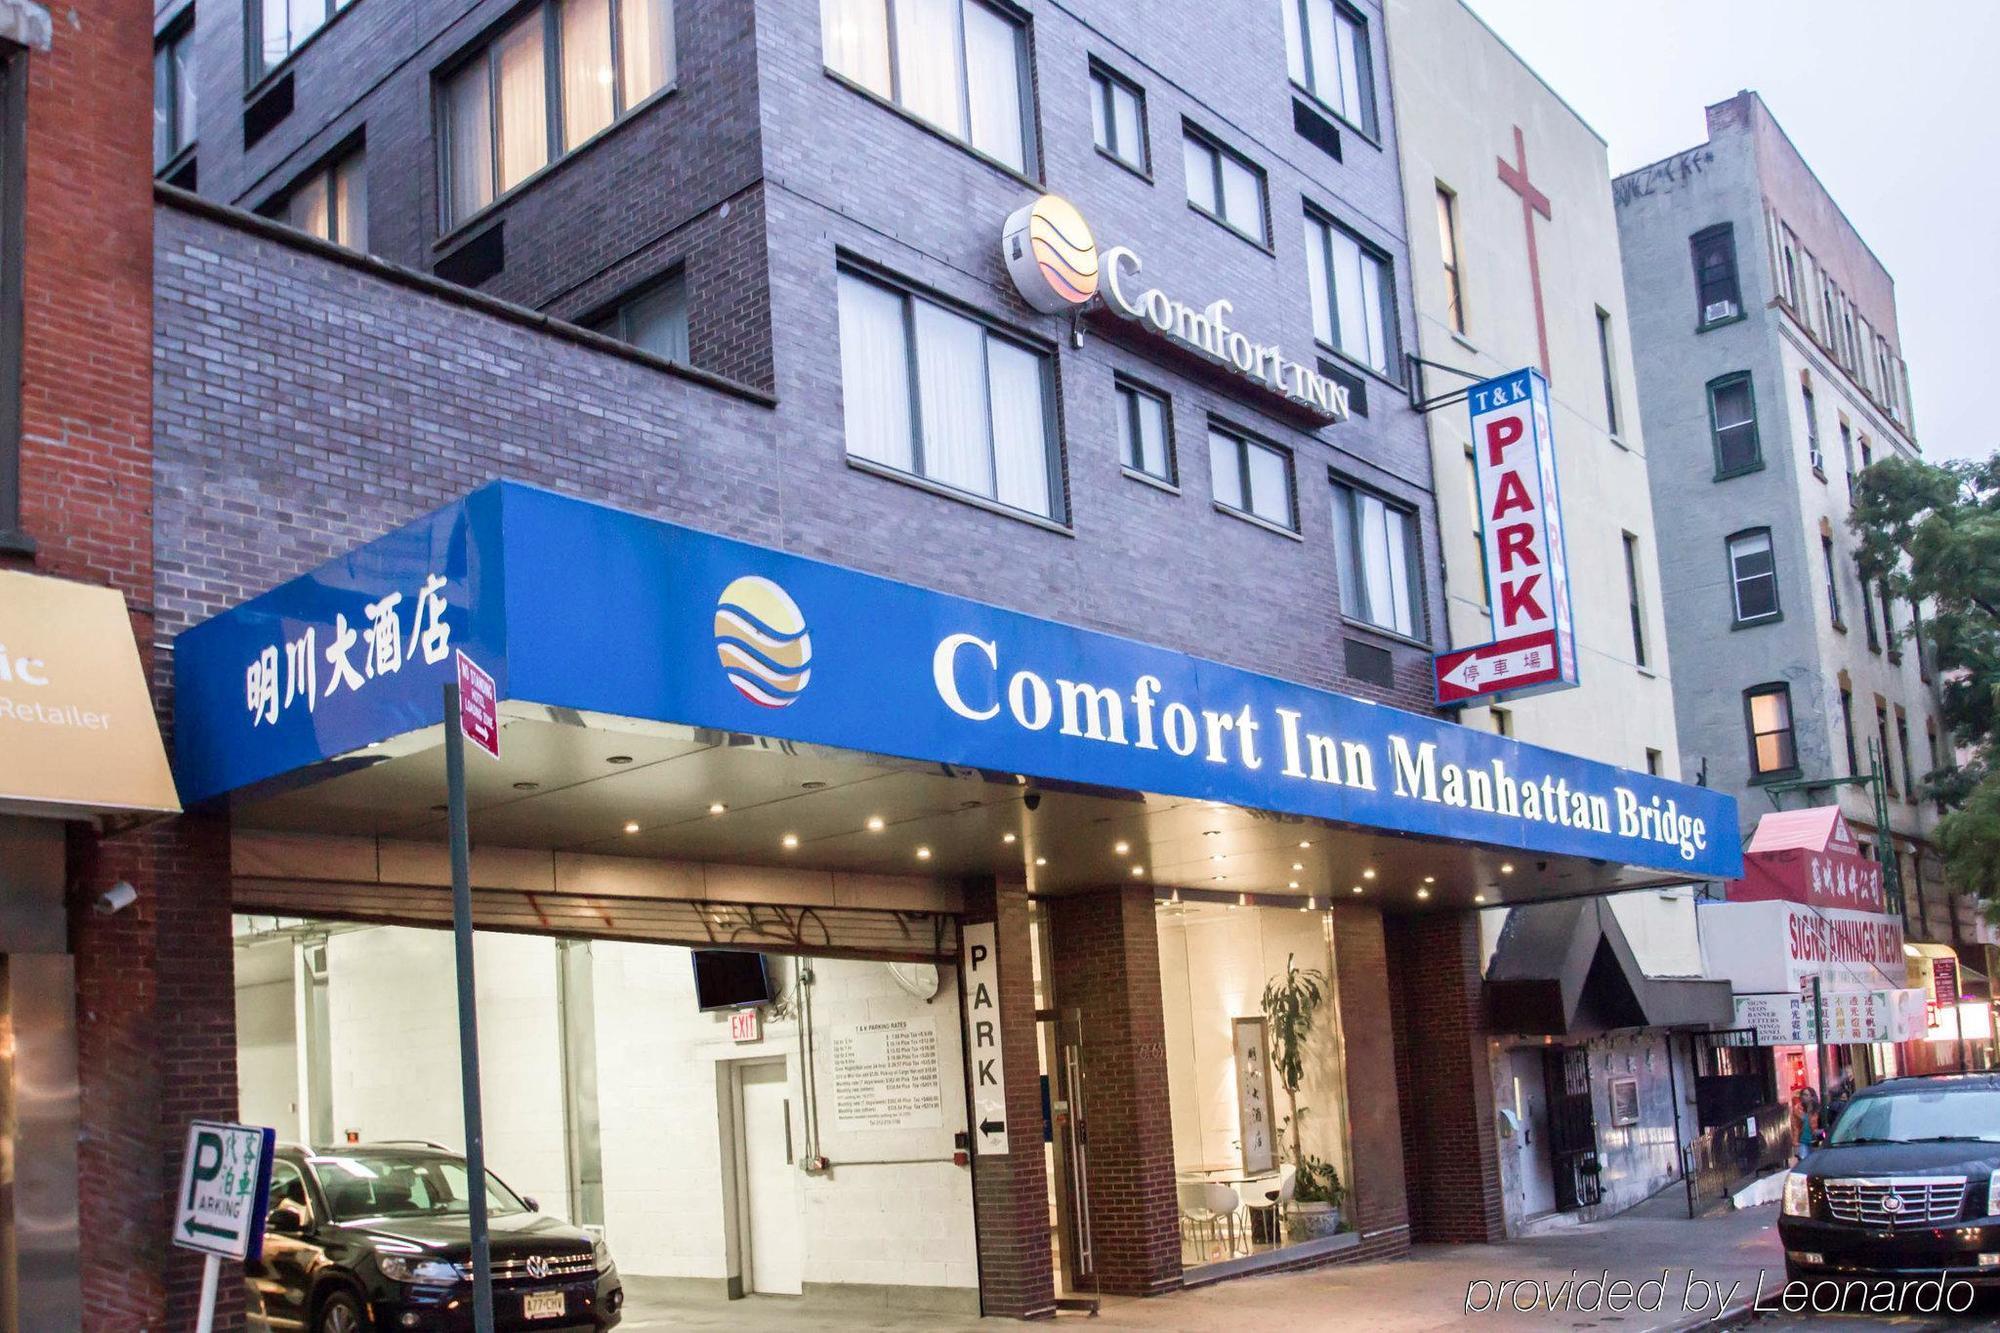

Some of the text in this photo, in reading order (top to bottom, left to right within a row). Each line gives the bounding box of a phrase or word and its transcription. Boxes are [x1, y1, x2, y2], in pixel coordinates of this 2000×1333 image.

[1099, 246, 1349, 420] Comfort INN
[1486, 415, 1547, 628] PARK
[246, 573, 451, 727] 明川大酒店
[1463, 651, 1541, 683] 停車場
[933, 633, 1707, 861] Comfort Inn Manhattan Bridge
[1789, 913, 1827, 961] SIGNS
[1829, 919, 1877, 962] AWNINGS
[732, 1014, 754, 1039] EXIT
[970, 944, 998, 1087] PARK
